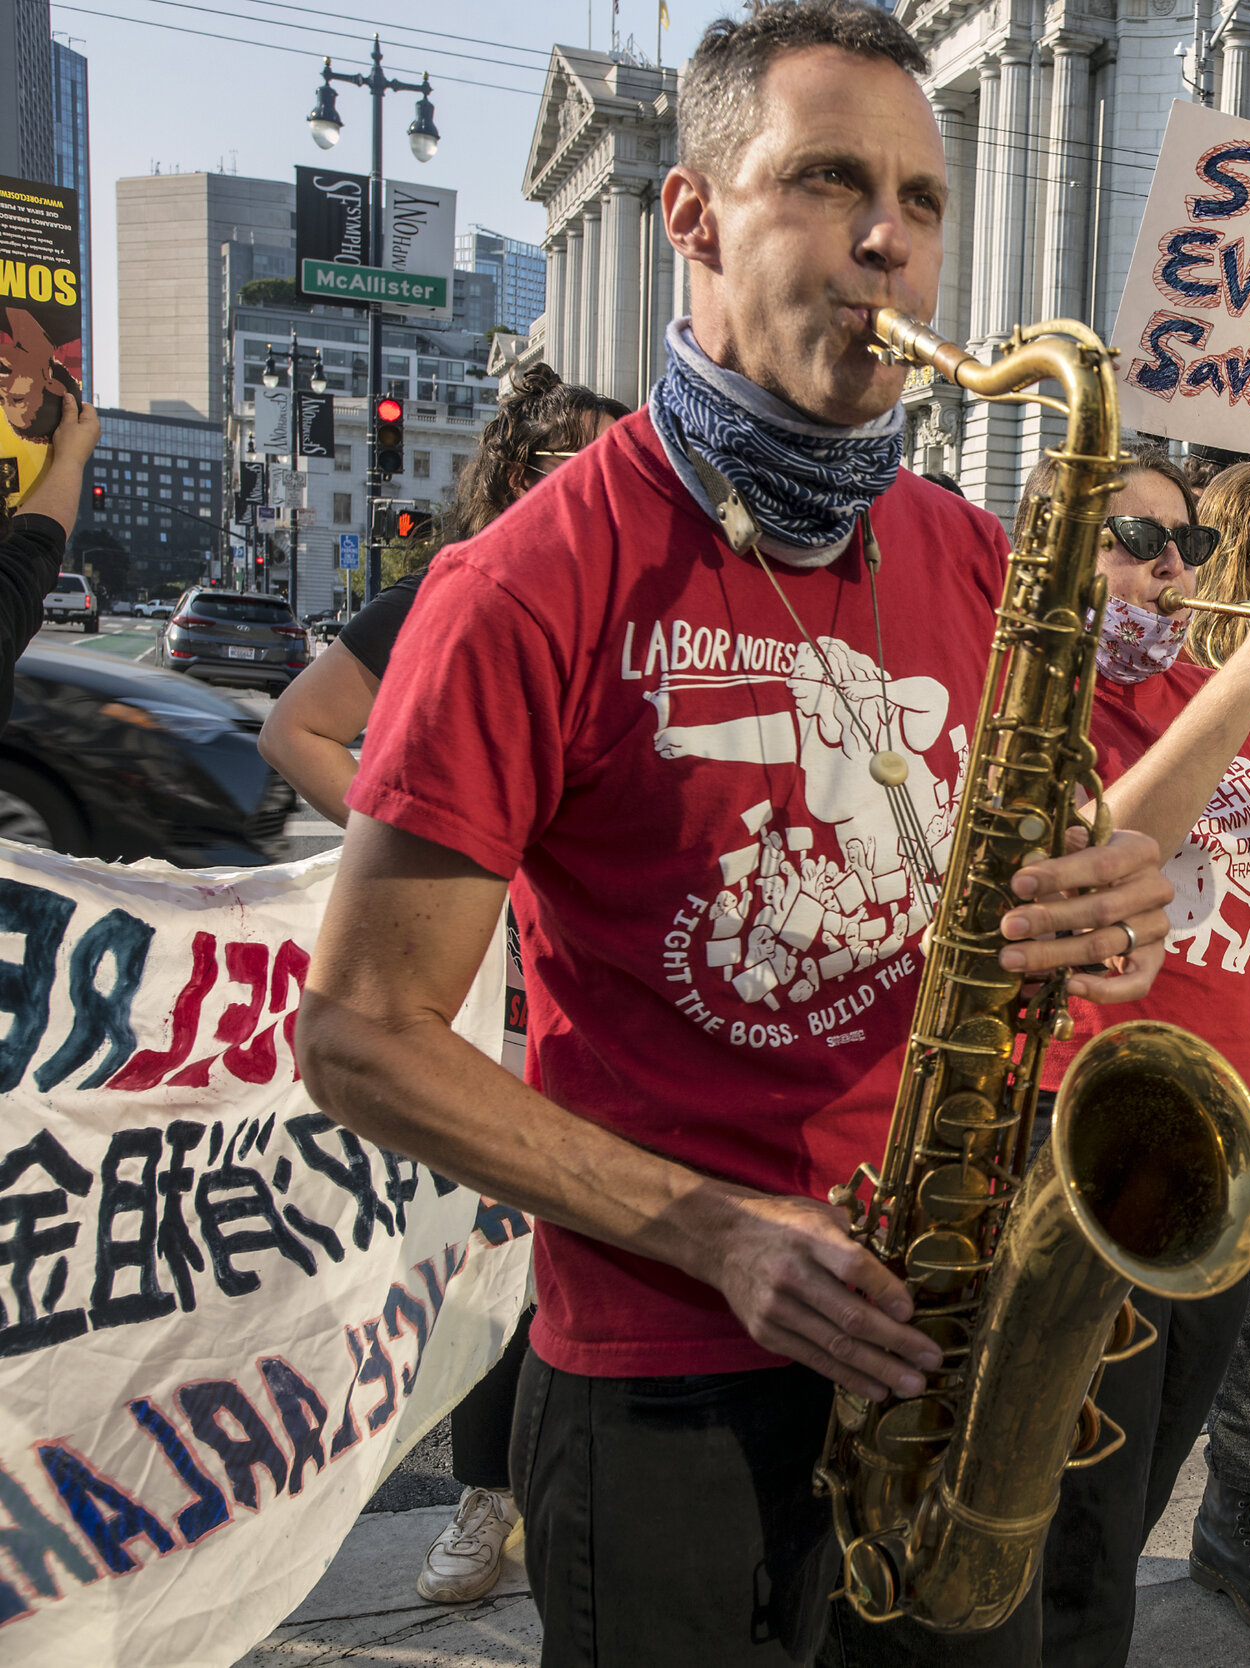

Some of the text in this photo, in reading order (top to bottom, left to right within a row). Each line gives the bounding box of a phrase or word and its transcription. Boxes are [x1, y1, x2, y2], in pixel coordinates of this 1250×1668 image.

[316, 268, 434, 299] McAllister
[621, 620, 797, 680] LABOR NOTES
[663, 894, 708, 984] FIGHT
[875, 953, 916, 990] THE
[675, 989, 725, 1035] THE
[807, 985, 876, 1036] BUILD
[730, 1021, 799, 1049] BOSS.
